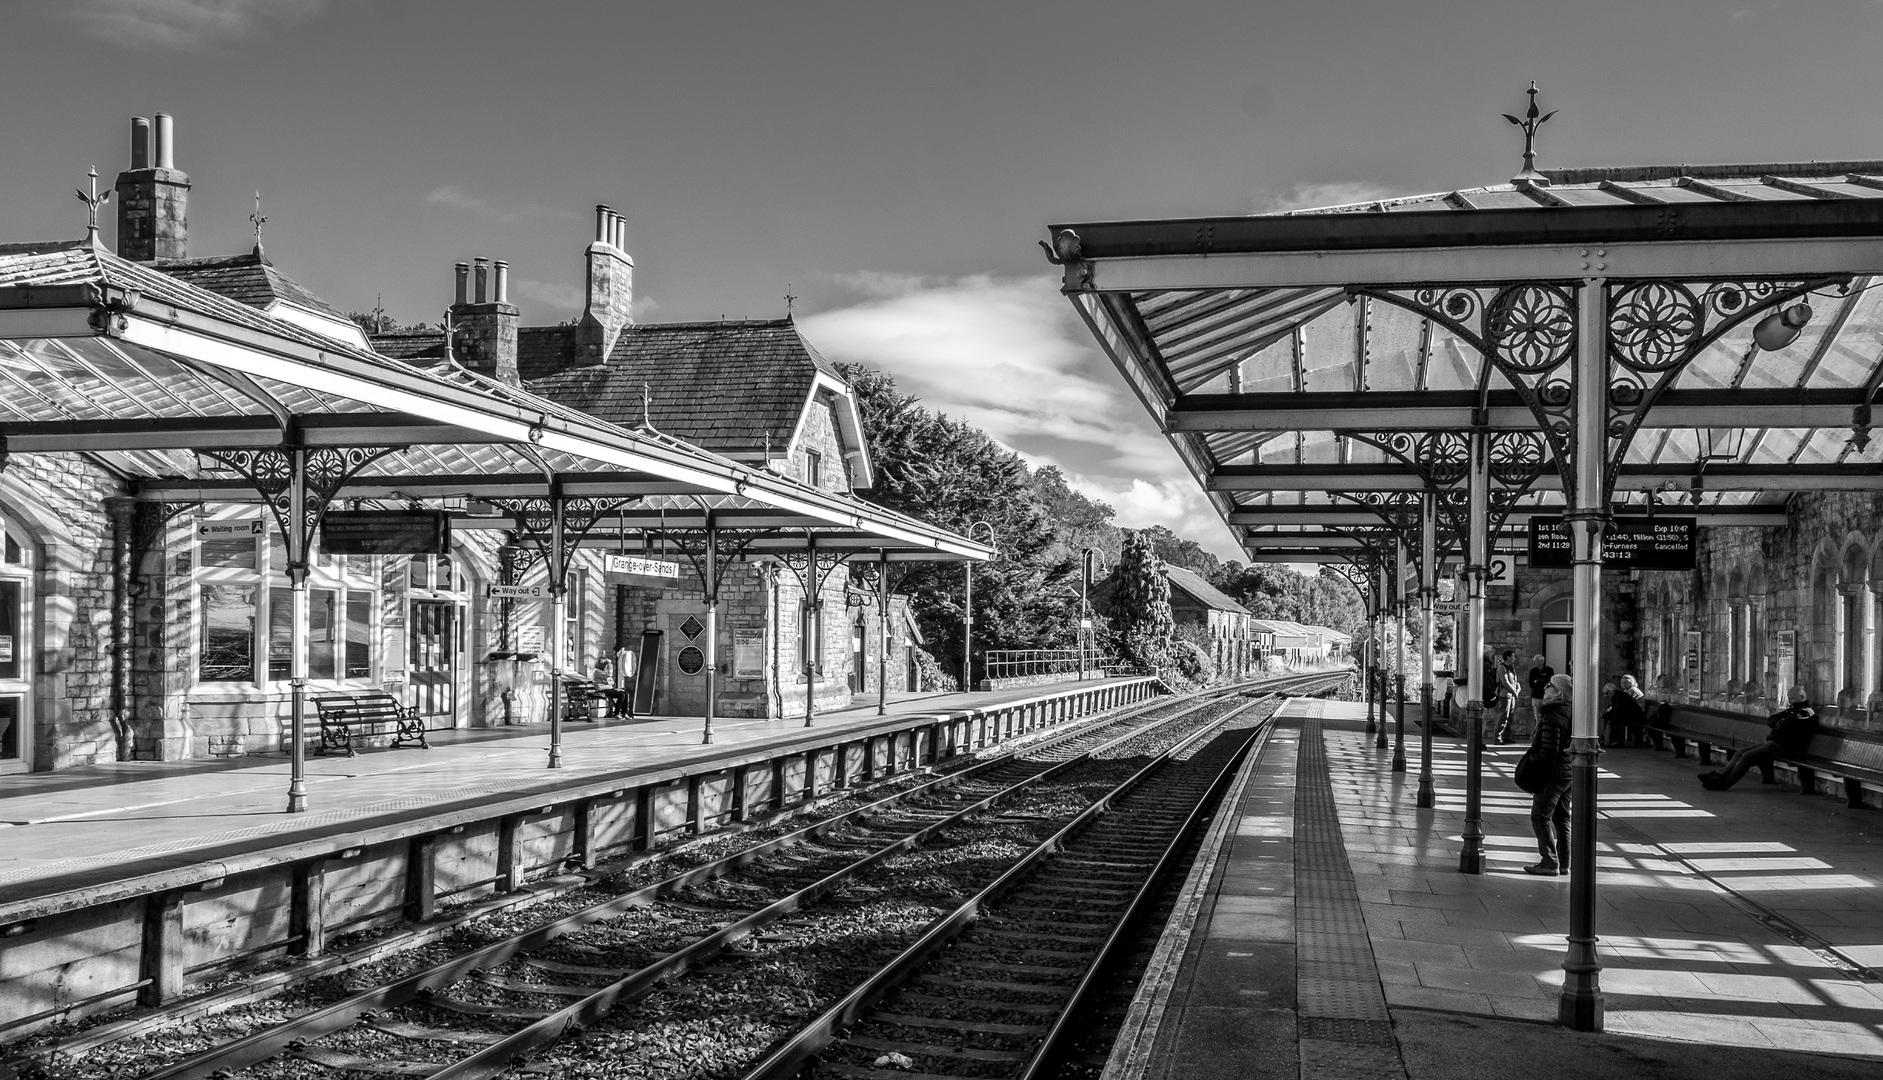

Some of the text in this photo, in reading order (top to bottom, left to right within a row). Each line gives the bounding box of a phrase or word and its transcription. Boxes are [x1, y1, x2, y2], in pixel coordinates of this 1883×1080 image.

[211, 525, 232, 533] Waiting
[1654, 525, 1668, 533] Exp
[1538, 541, 1550, 549] 2nd
[1654, 542, 1688, 550] Cancelled
[613, 557, 673, 574] Grange-over-Sands
[1491, 559, 1506, 580] 2
[502, 587, 530, 595] Way out
[1433, 603, 1448, 611] Way
